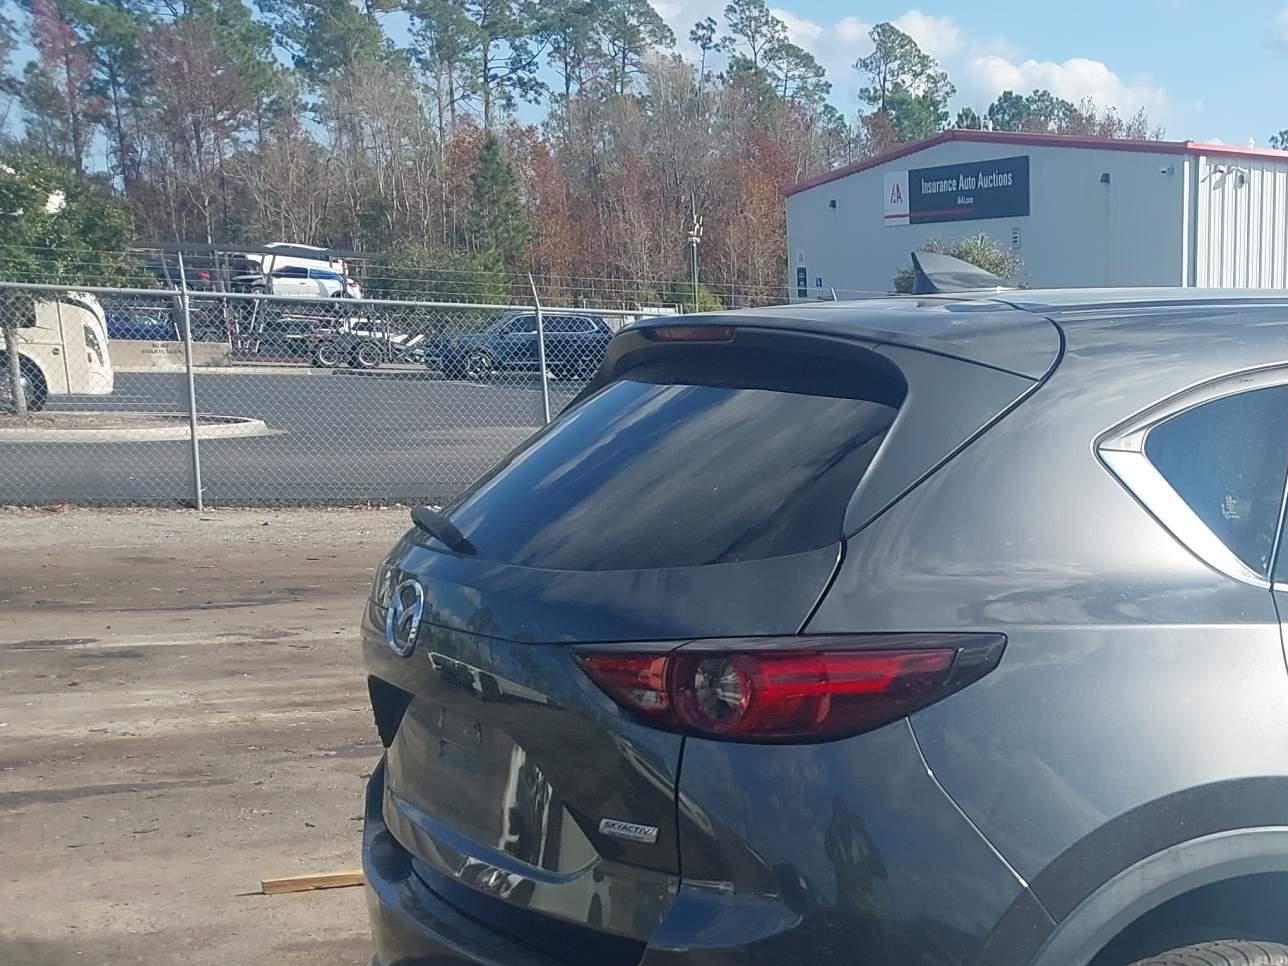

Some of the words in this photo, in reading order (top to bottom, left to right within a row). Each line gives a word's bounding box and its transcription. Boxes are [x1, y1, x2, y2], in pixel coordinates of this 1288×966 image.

[921, 177, 957, 194] Insurance
[958, 173, 976, 191] Auto
[977, 169, 1013, 189] Auctions
